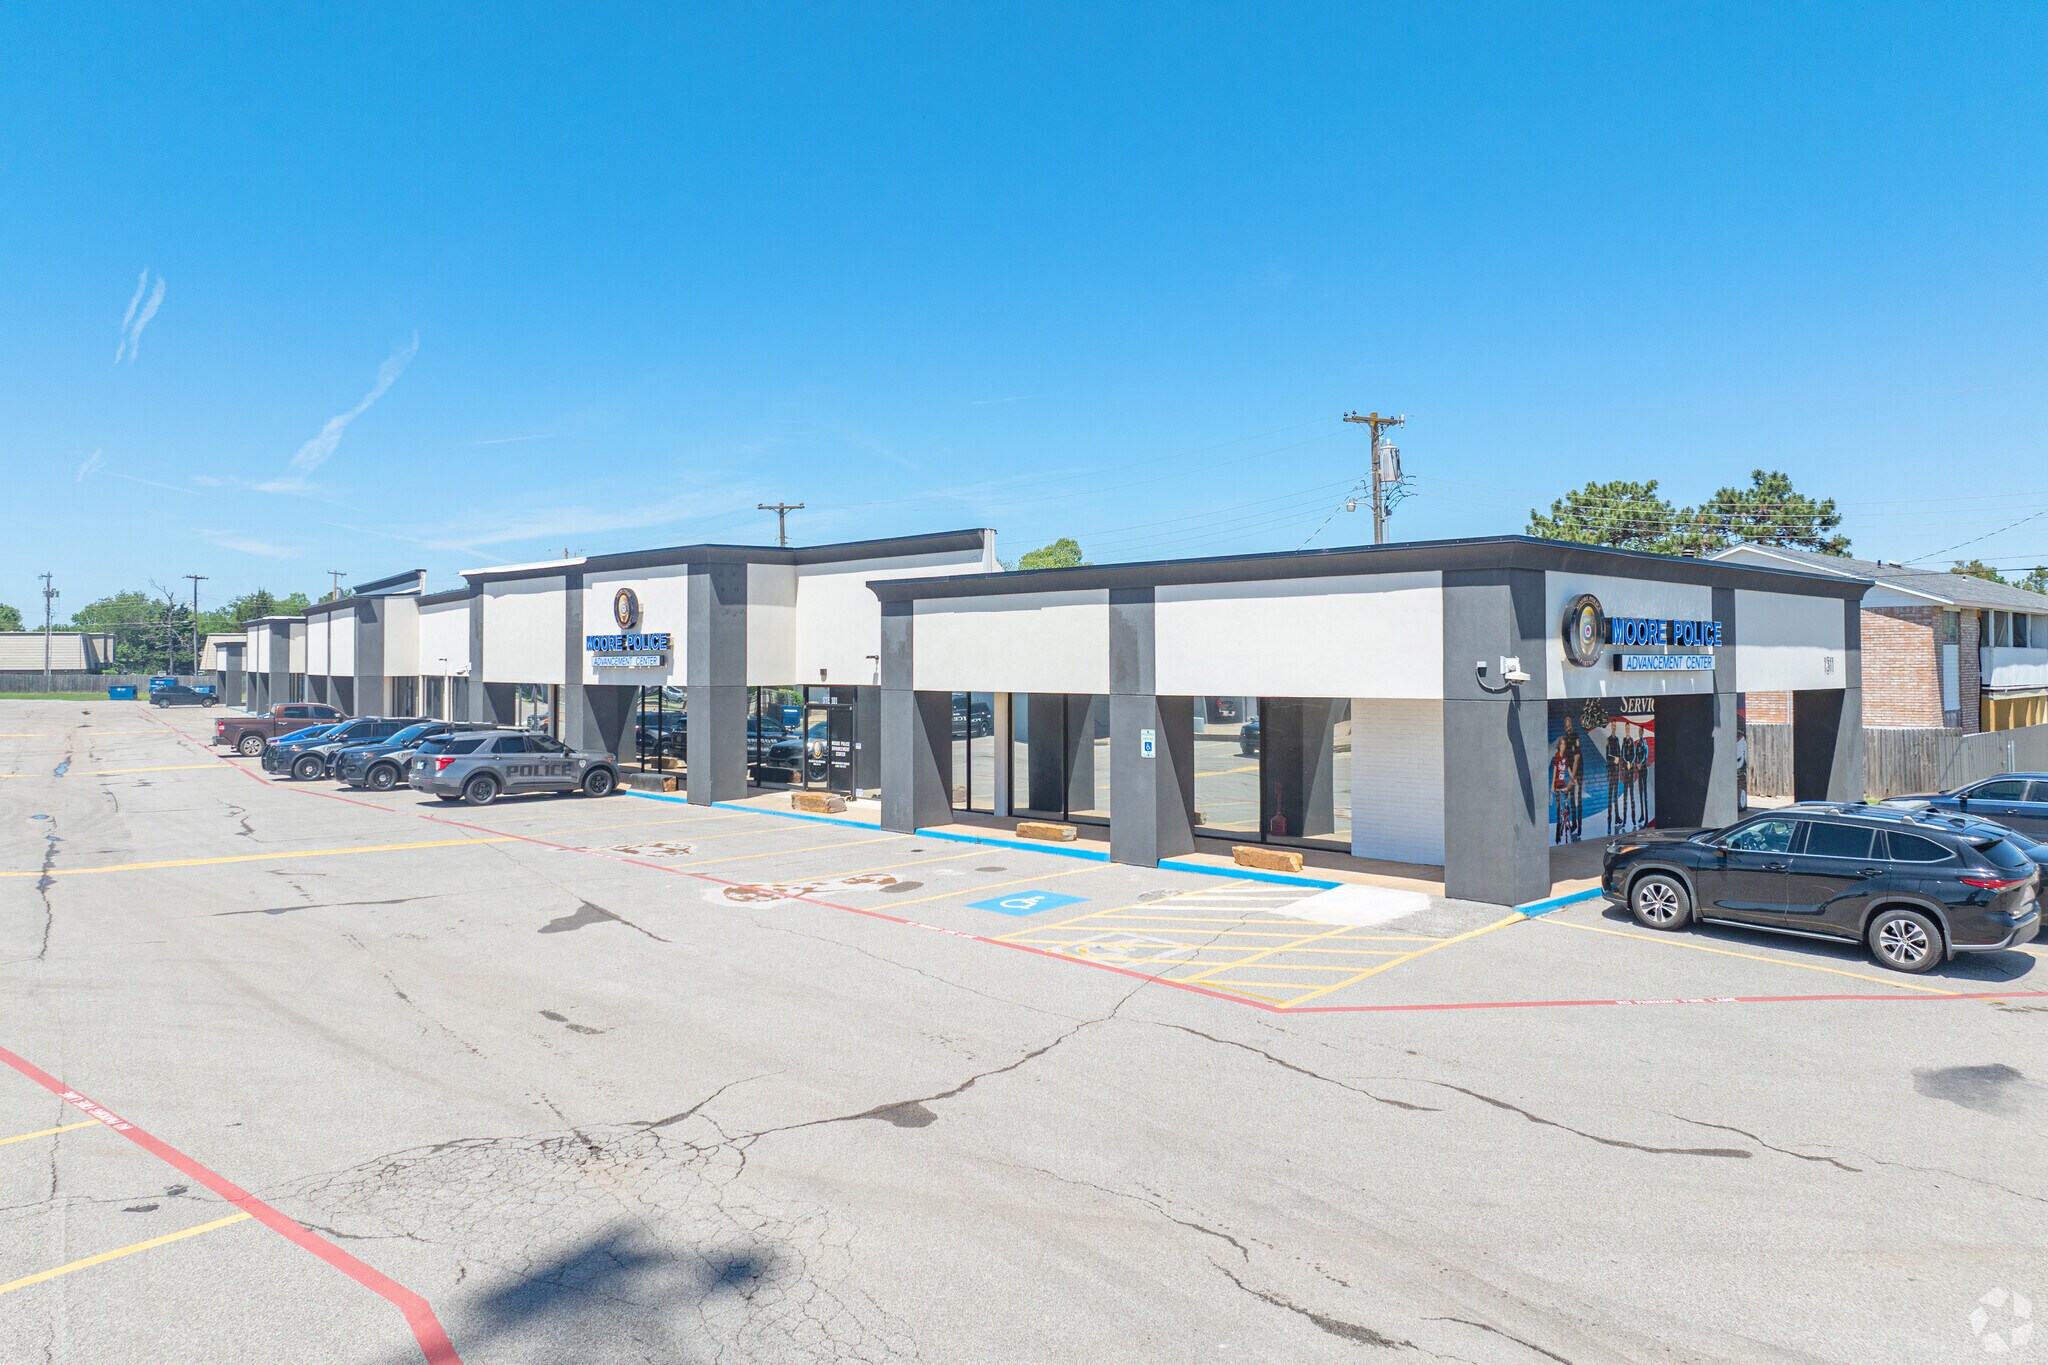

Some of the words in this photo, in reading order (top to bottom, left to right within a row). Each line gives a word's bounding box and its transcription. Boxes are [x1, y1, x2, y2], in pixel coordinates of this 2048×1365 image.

[1611, 617, 1667, 646] MOORE
[1673, 620, 1722, 647] POLICE
[586, 635, 623, 651] MOORE
[627, 633, 667, 651] POLICE
[594, 656, 633, 666] ADVANCEMENT
[636, 656, 657, 665] CENTER
[1626, 656, 1683, 670] ADVANCEMENT
[1685, 656, 1712, 670] CENTER
[506, 764, 572, 778] POLICE
